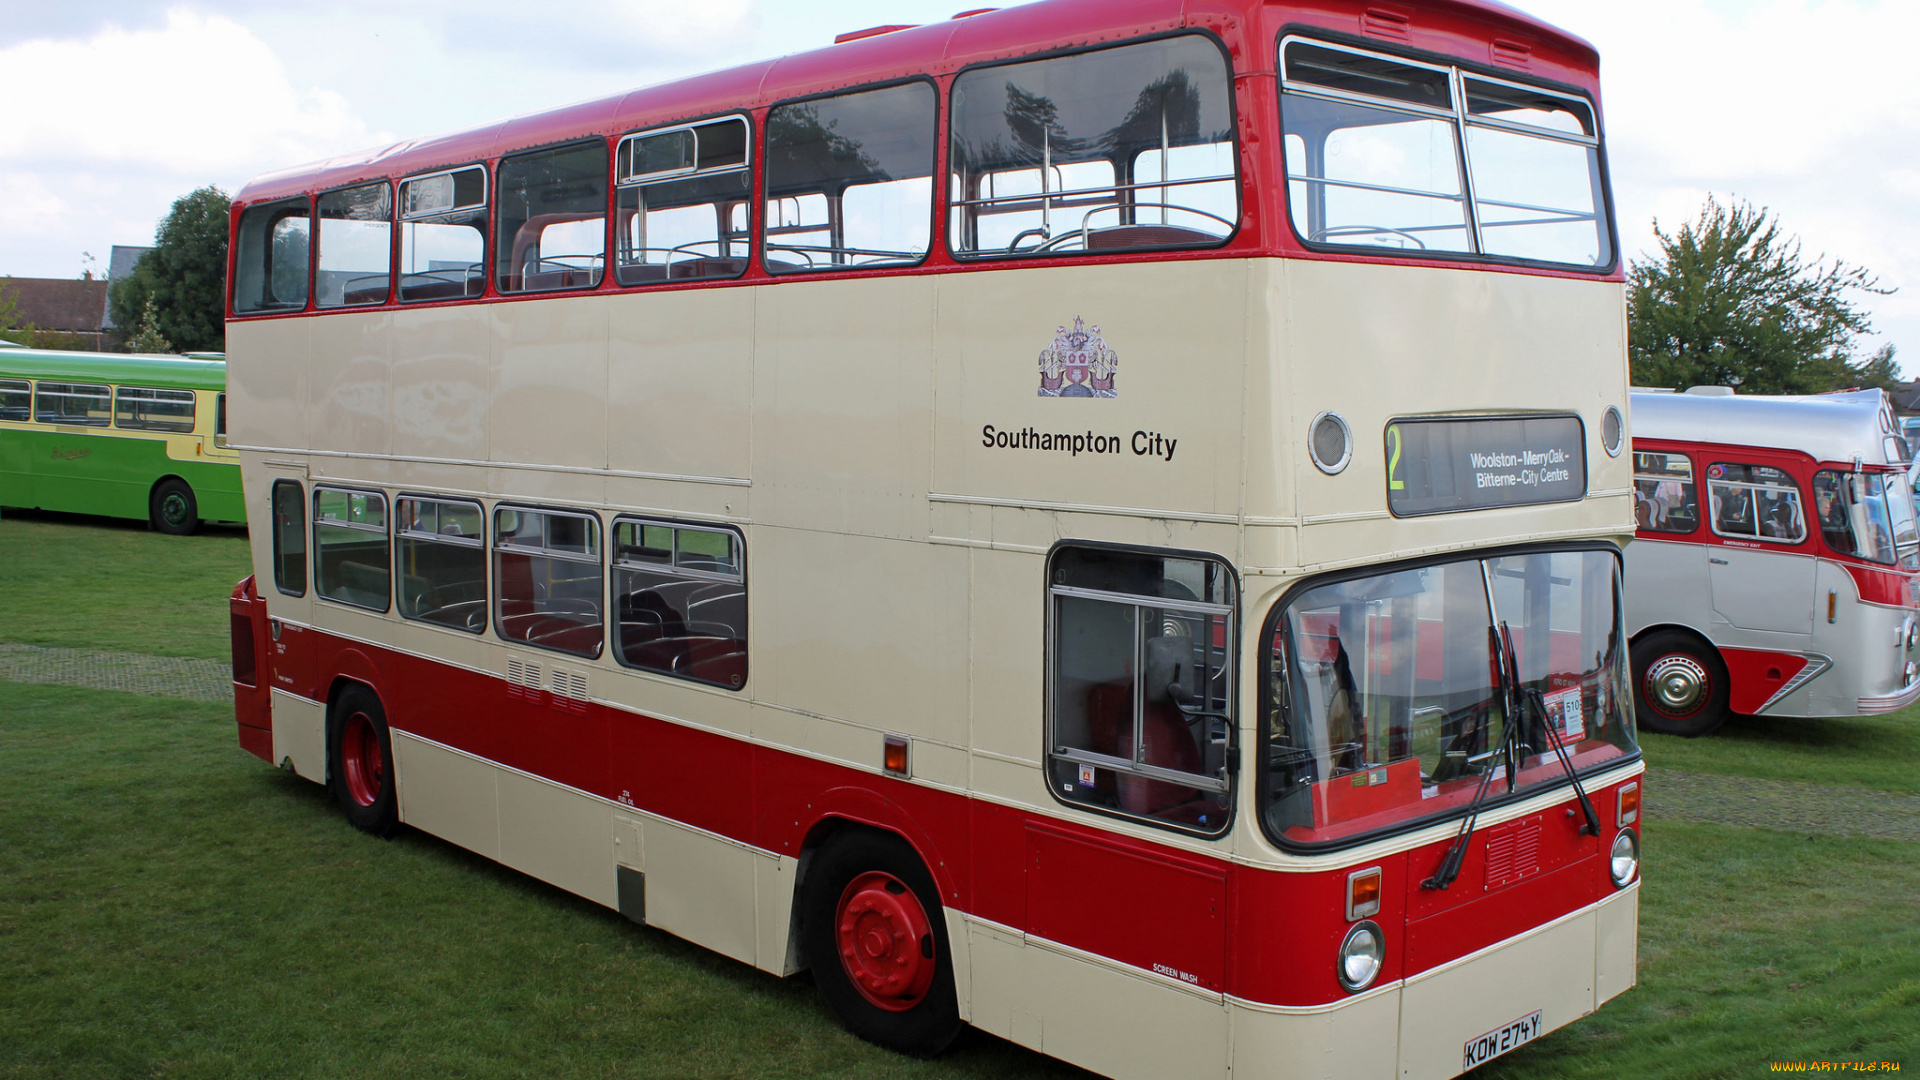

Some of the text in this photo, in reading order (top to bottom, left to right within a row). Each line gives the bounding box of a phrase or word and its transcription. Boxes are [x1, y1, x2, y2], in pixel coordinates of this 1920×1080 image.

[982, 424, 1178, 462] Southampton City
[1387, 424, 1405, 490] 2
[1540, 467, 1569, 483] Centre
[1153, 963, 1198, 984] SCREEN WASH
